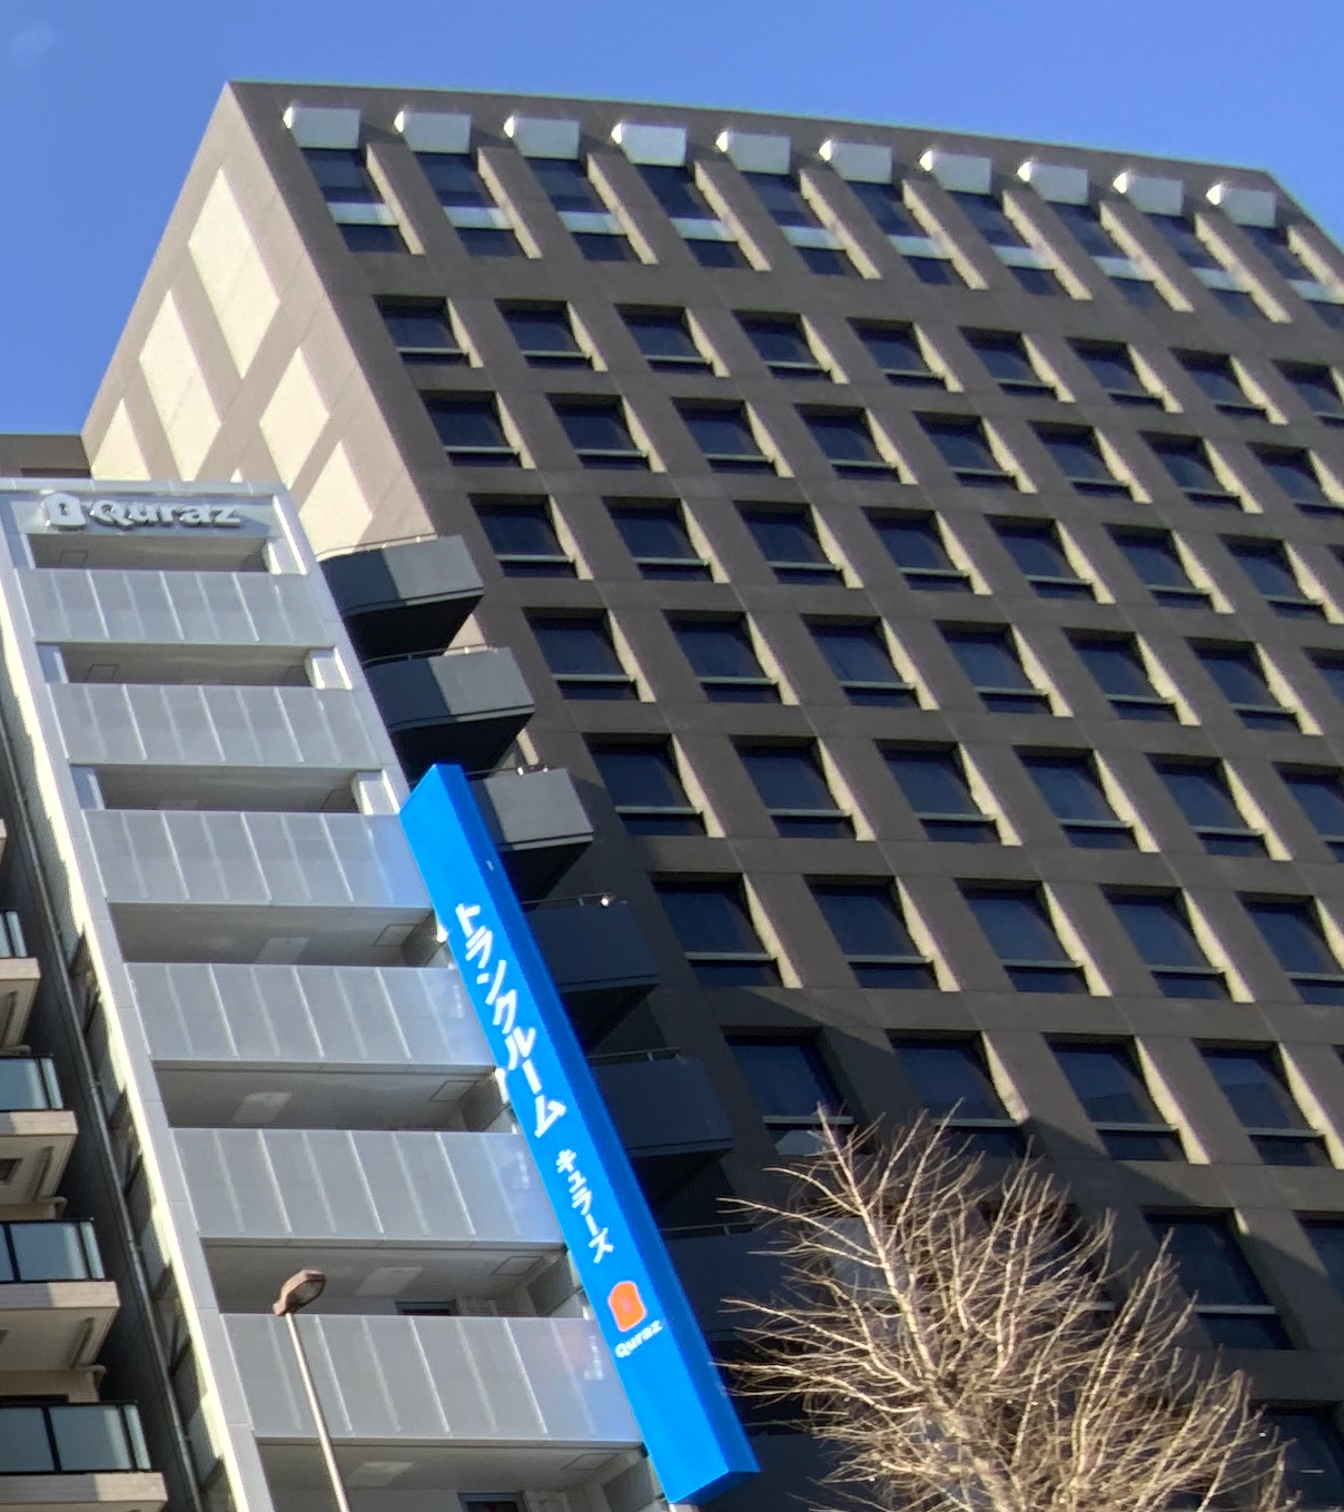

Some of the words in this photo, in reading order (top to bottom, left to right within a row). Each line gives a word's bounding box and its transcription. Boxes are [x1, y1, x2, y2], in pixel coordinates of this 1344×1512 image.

[89, 499, 241, 530] Quraz
[455, 902, 567, 1138] トランクルーム
[556, 1148, 614, 1264] キュラーズ
[615, 1320, 663, 1358] Quraz
